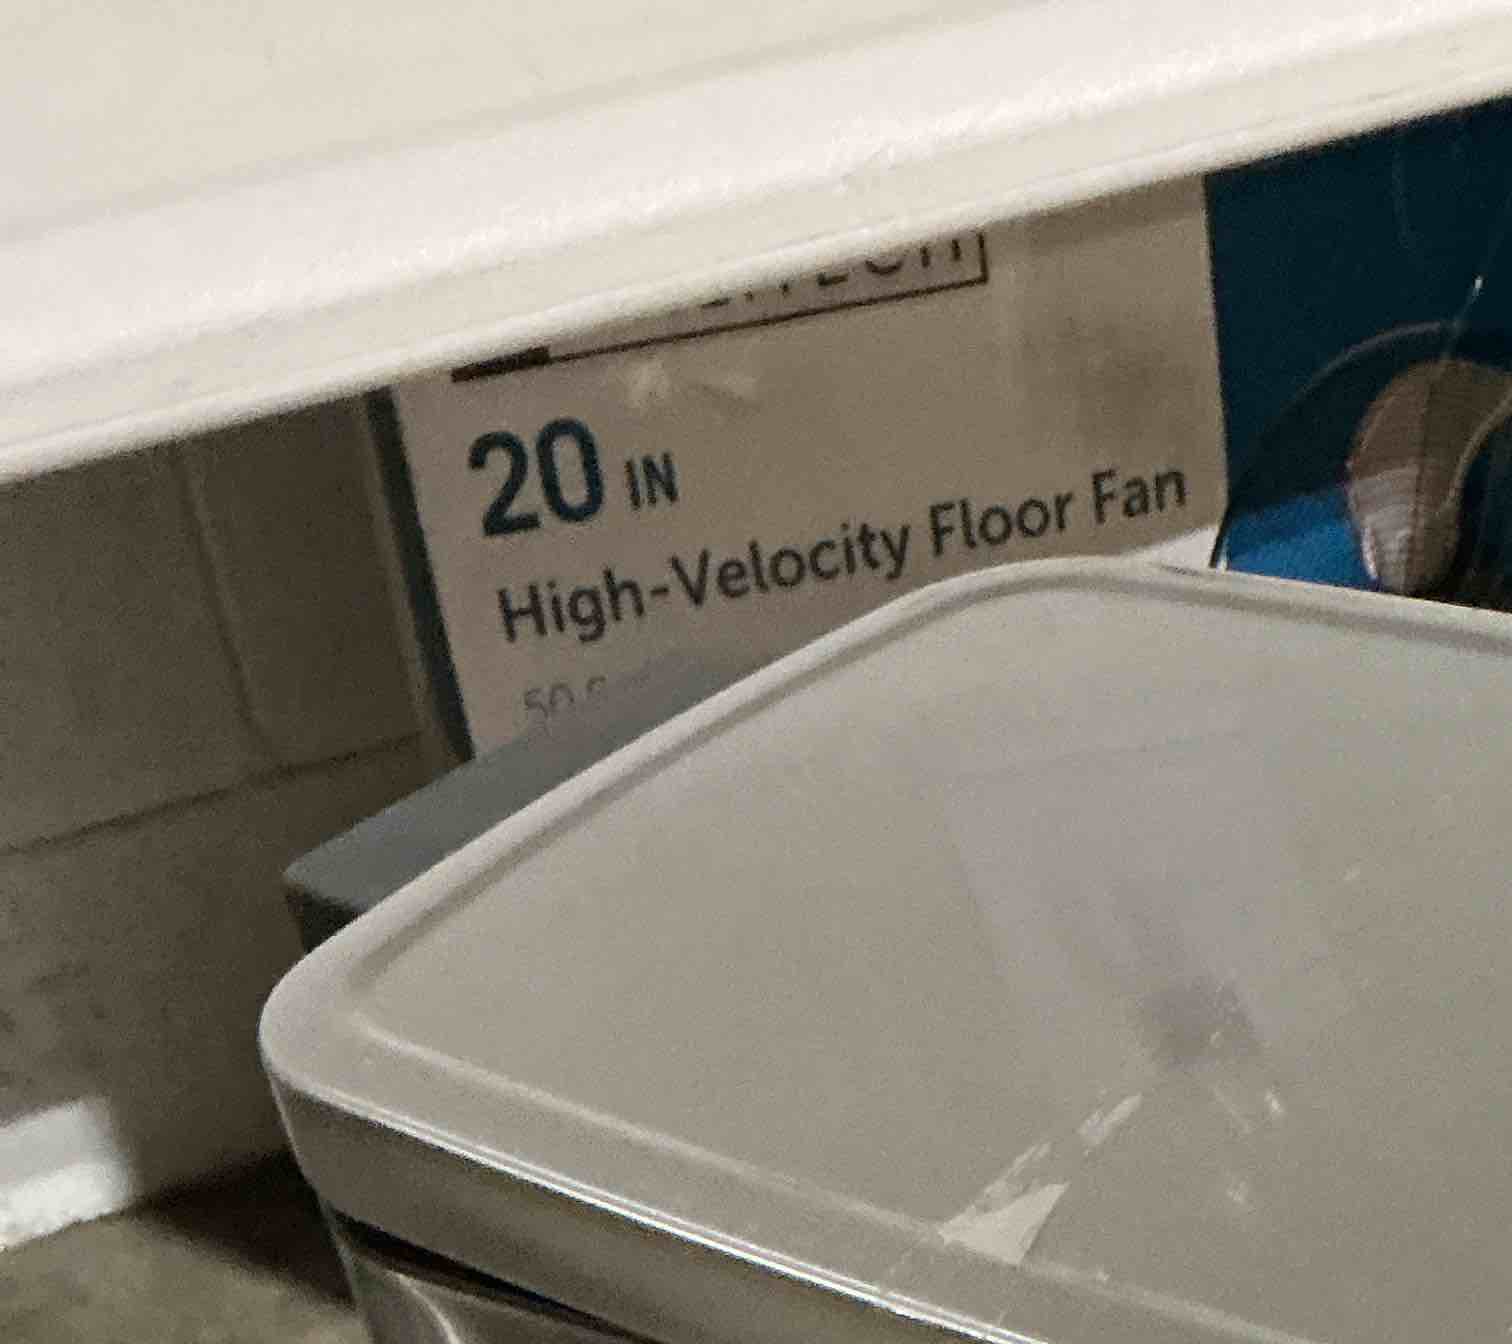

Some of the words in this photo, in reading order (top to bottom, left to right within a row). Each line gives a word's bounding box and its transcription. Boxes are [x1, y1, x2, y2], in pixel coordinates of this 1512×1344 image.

[467, 417, 605, 537] 20
[625, 451, 680, 511] IN
[498, 522, 911, 643] High-Velocity
[930, 491, 1074, 557] Floor
[1092, 465, 1188, 519] Fan
